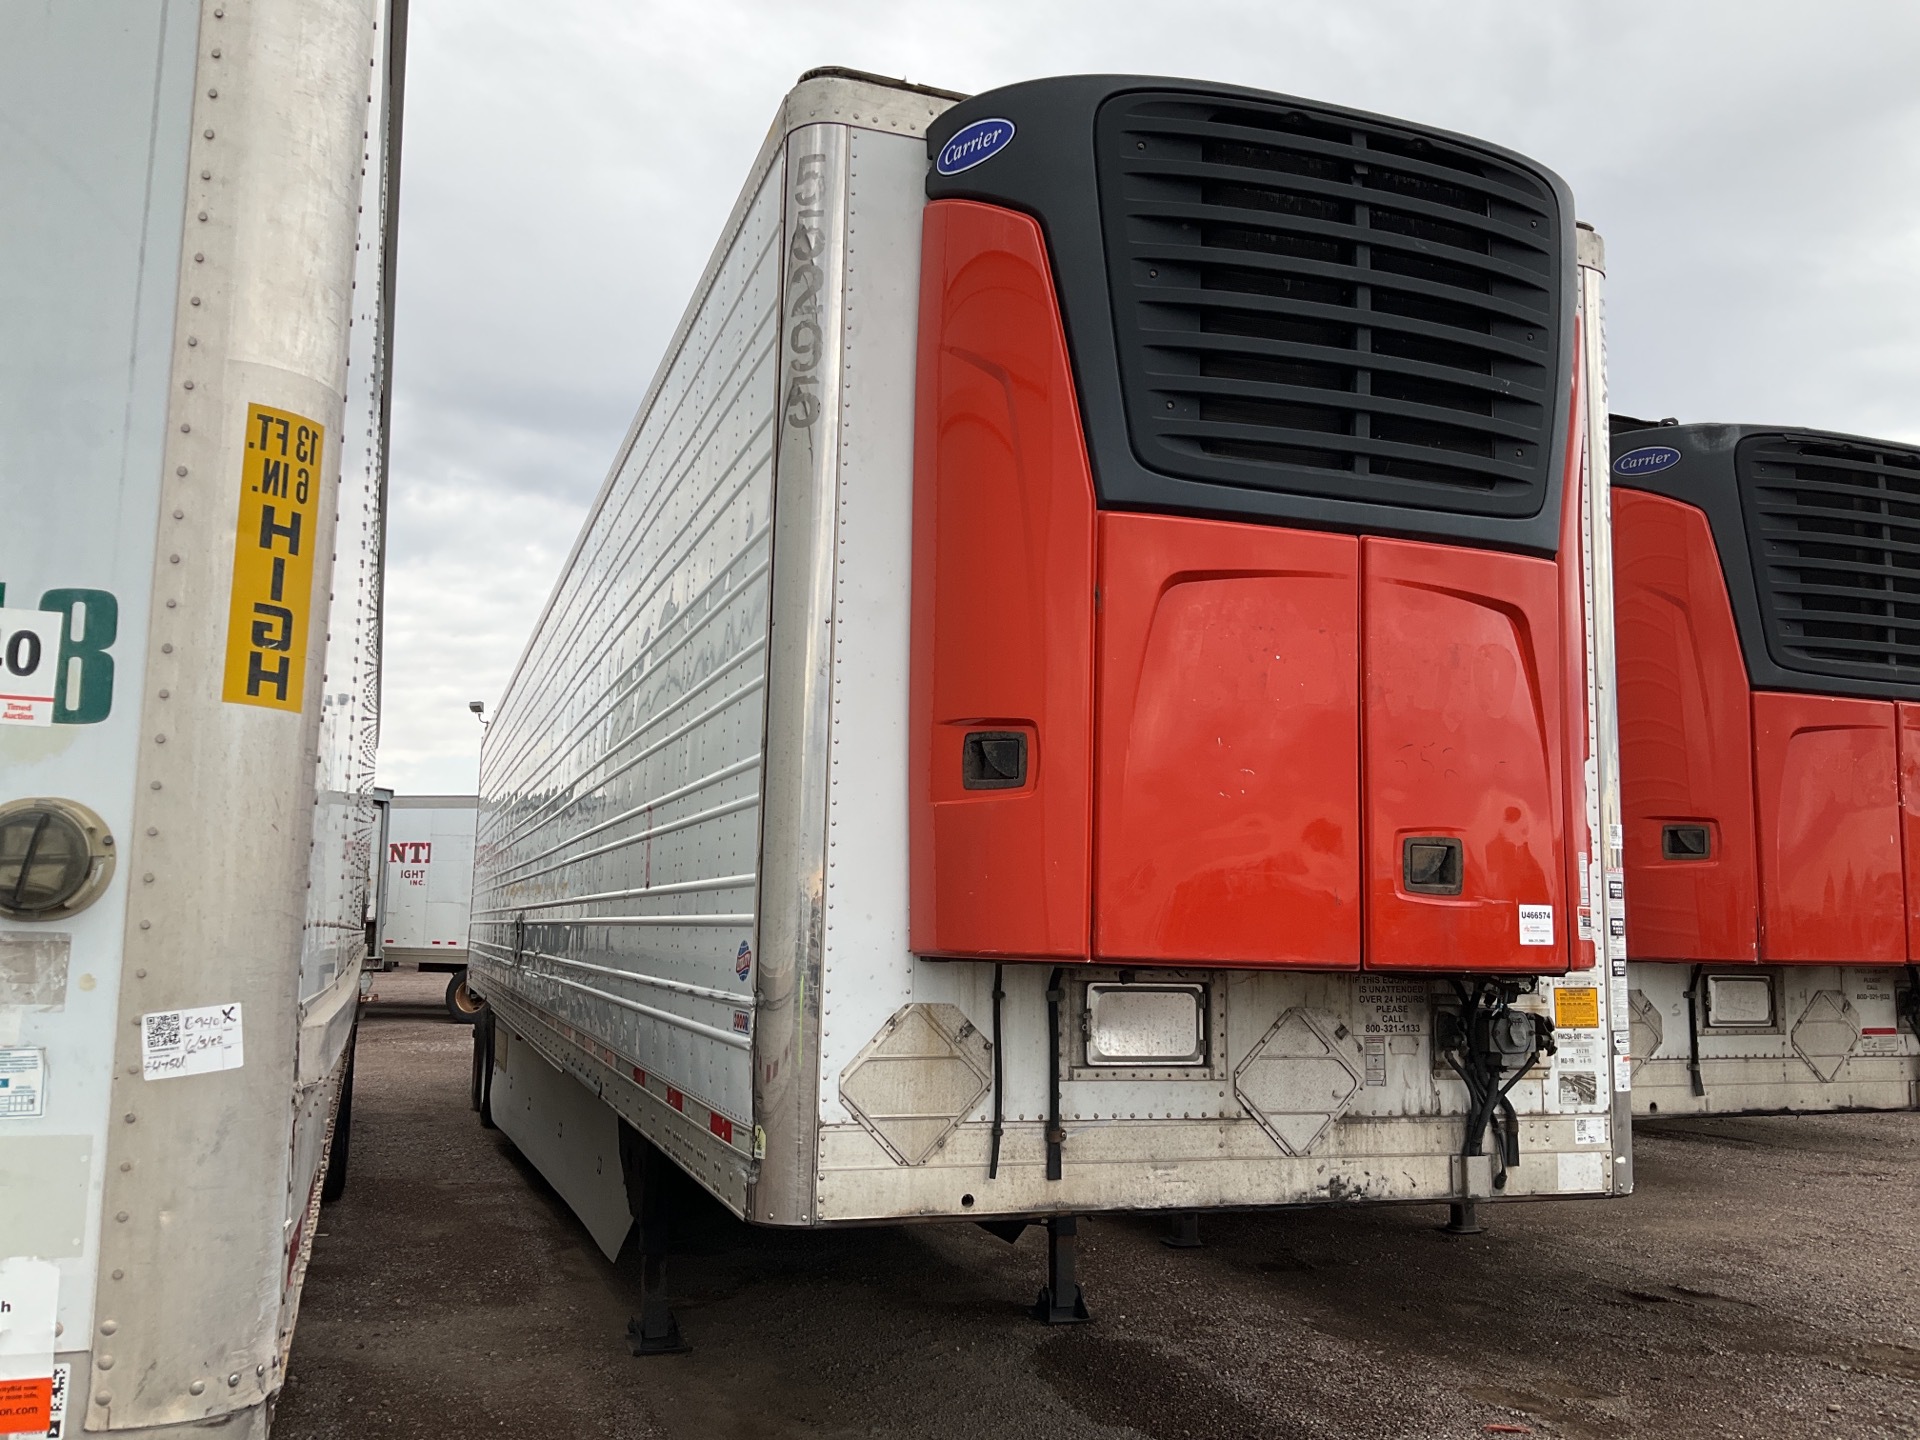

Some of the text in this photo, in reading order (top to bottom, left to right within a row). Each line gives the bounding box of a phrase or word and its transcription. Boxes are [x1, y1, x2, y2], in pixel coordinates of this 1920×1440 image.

[944, 126, 1003, 165] Carrier
[1620, 451, 1672, 471] Carrier
[7, 703, 32, 711] Timed
[2, 711, 34, 720] Auction
[1521, 911, 1551, 919] U466574
[1362, 976, 1380, 984] THIS
[1359, 985, 1424, 993] IS UNATTENDED
[1376, 1005, 1408, 1013] PLEASE
[1382, 1015, 1404, 1023] CALL
[1365, 1024, 1420, 1033] 800-321-1133
